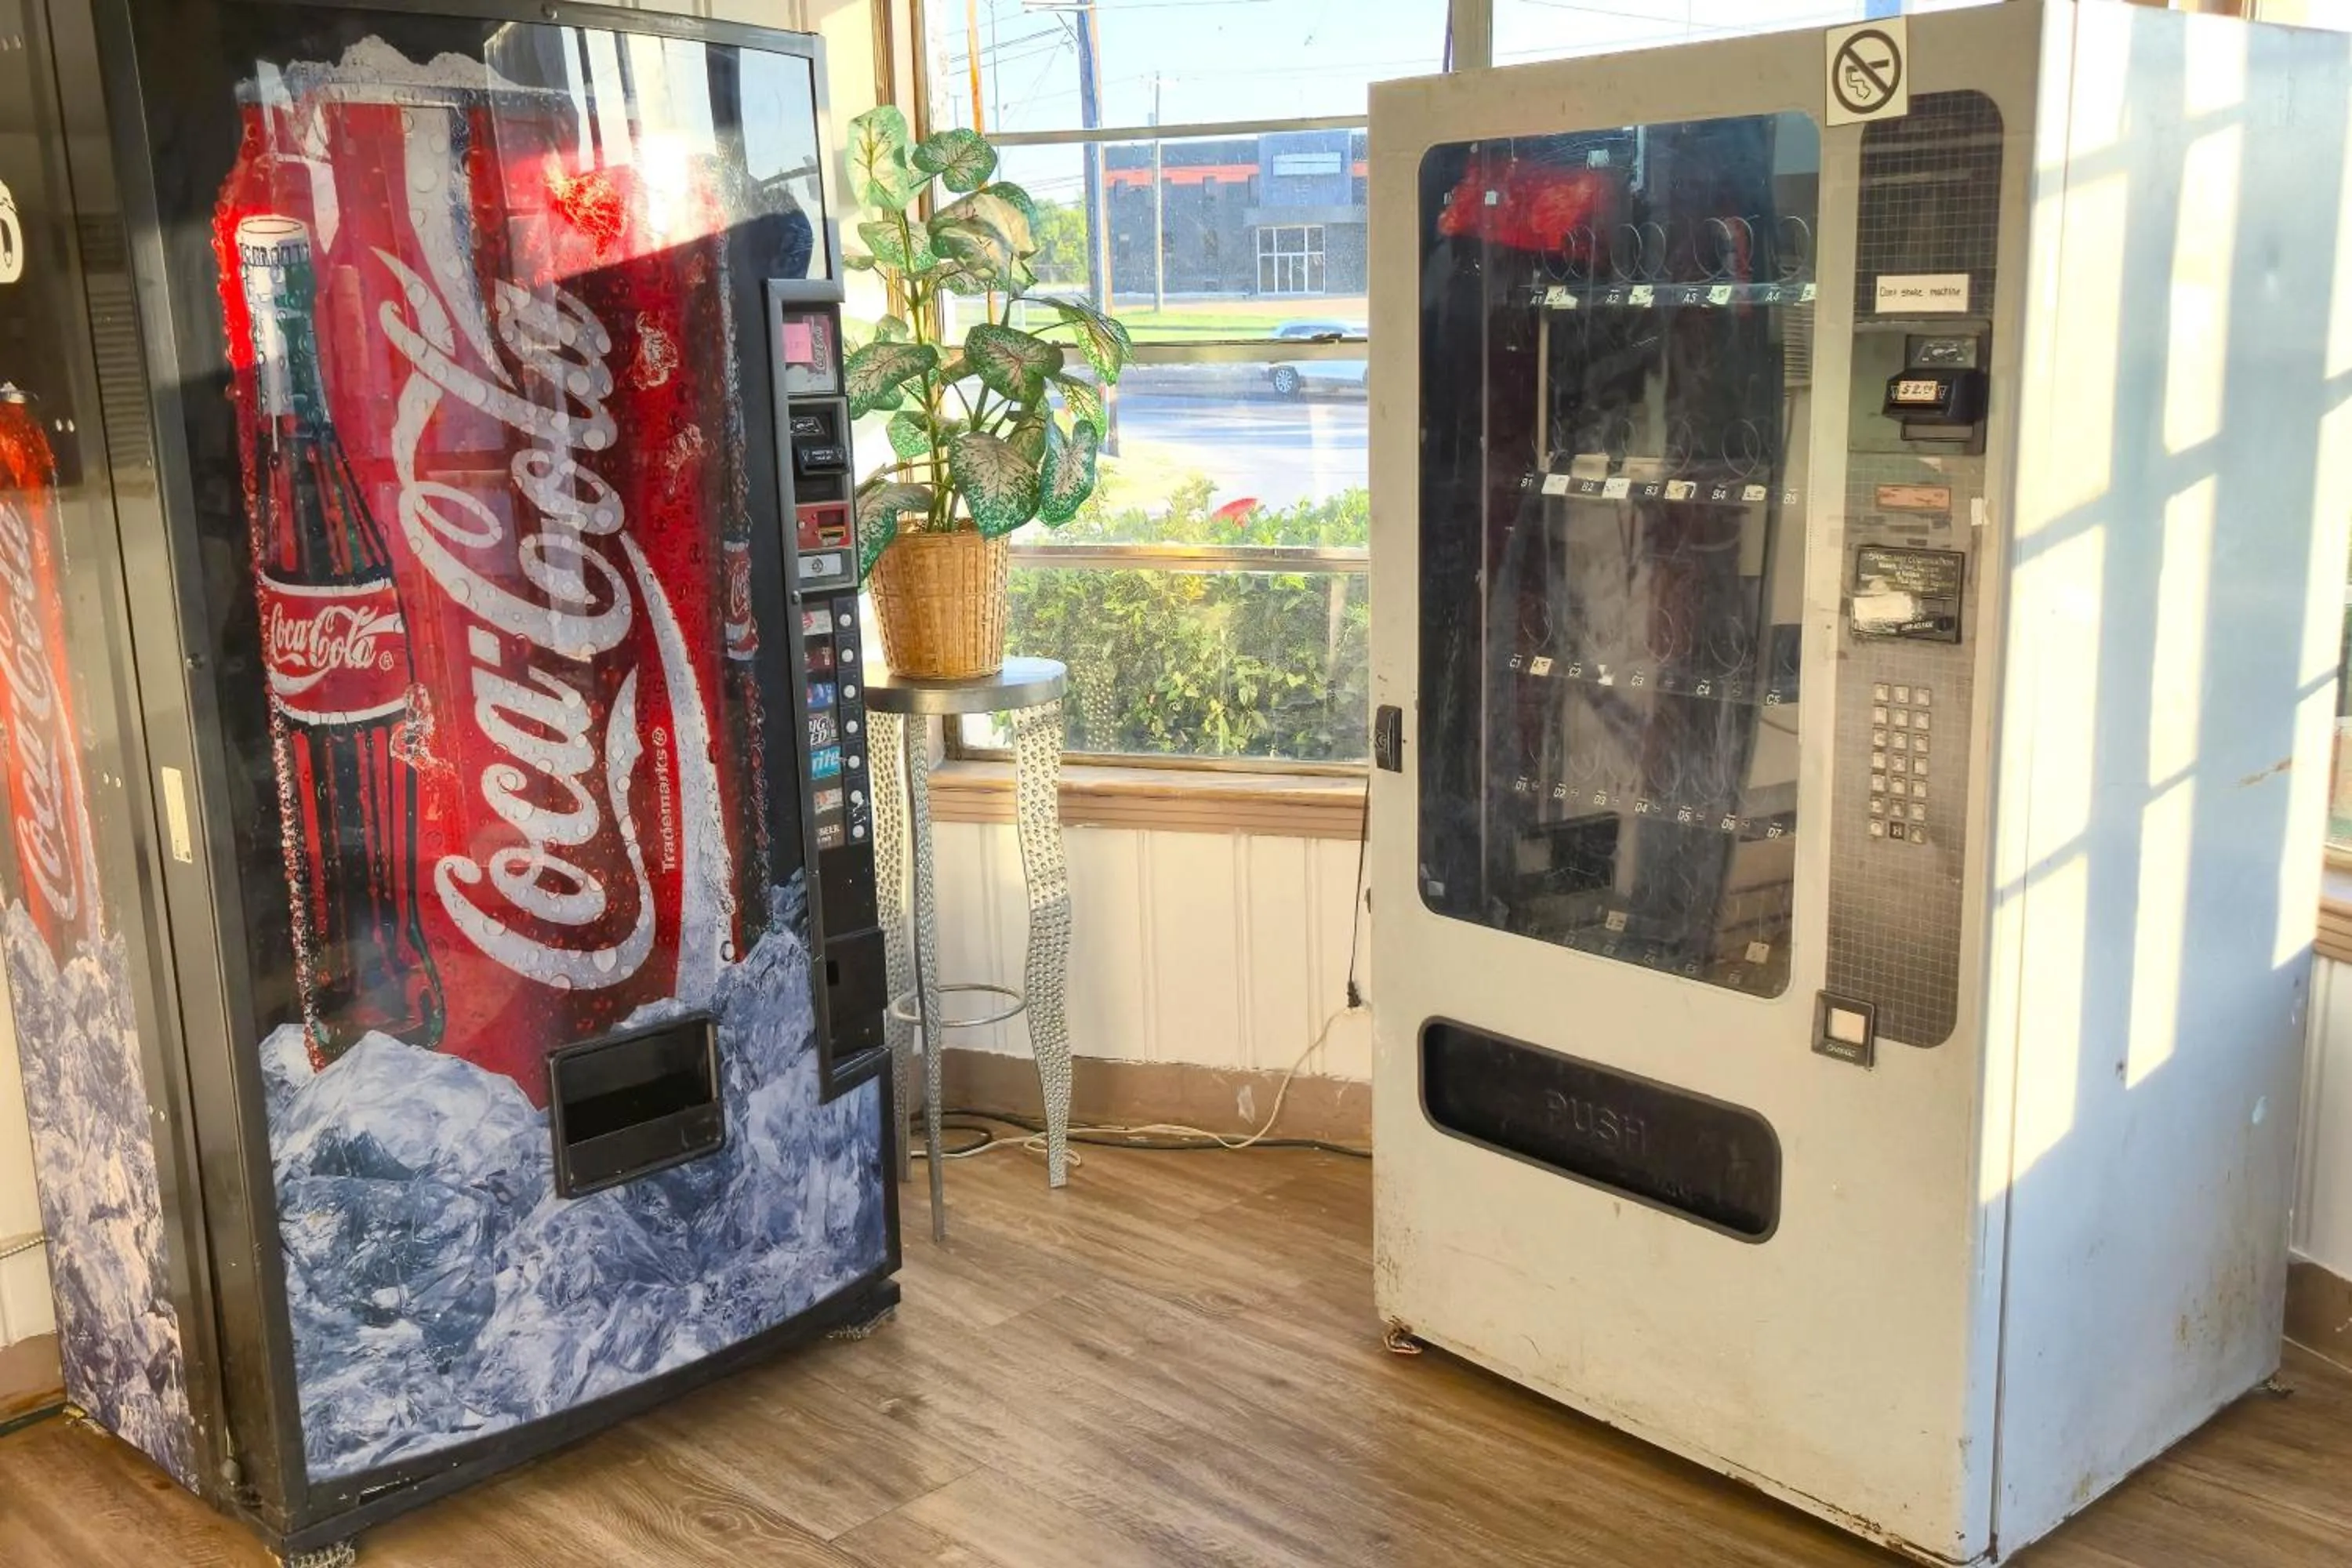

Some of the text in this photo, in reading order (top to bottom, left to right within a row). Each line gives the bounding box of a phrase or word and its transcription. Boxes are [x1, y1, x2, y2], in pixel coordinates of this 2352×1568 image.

[270, 601, 379, 670] Coca-Cola
[370, 245, 656, 992] Coca-Cola
[655, 748, 676, 873] Trademarks
[1544, 1087, 1646, 1155] PUSH
